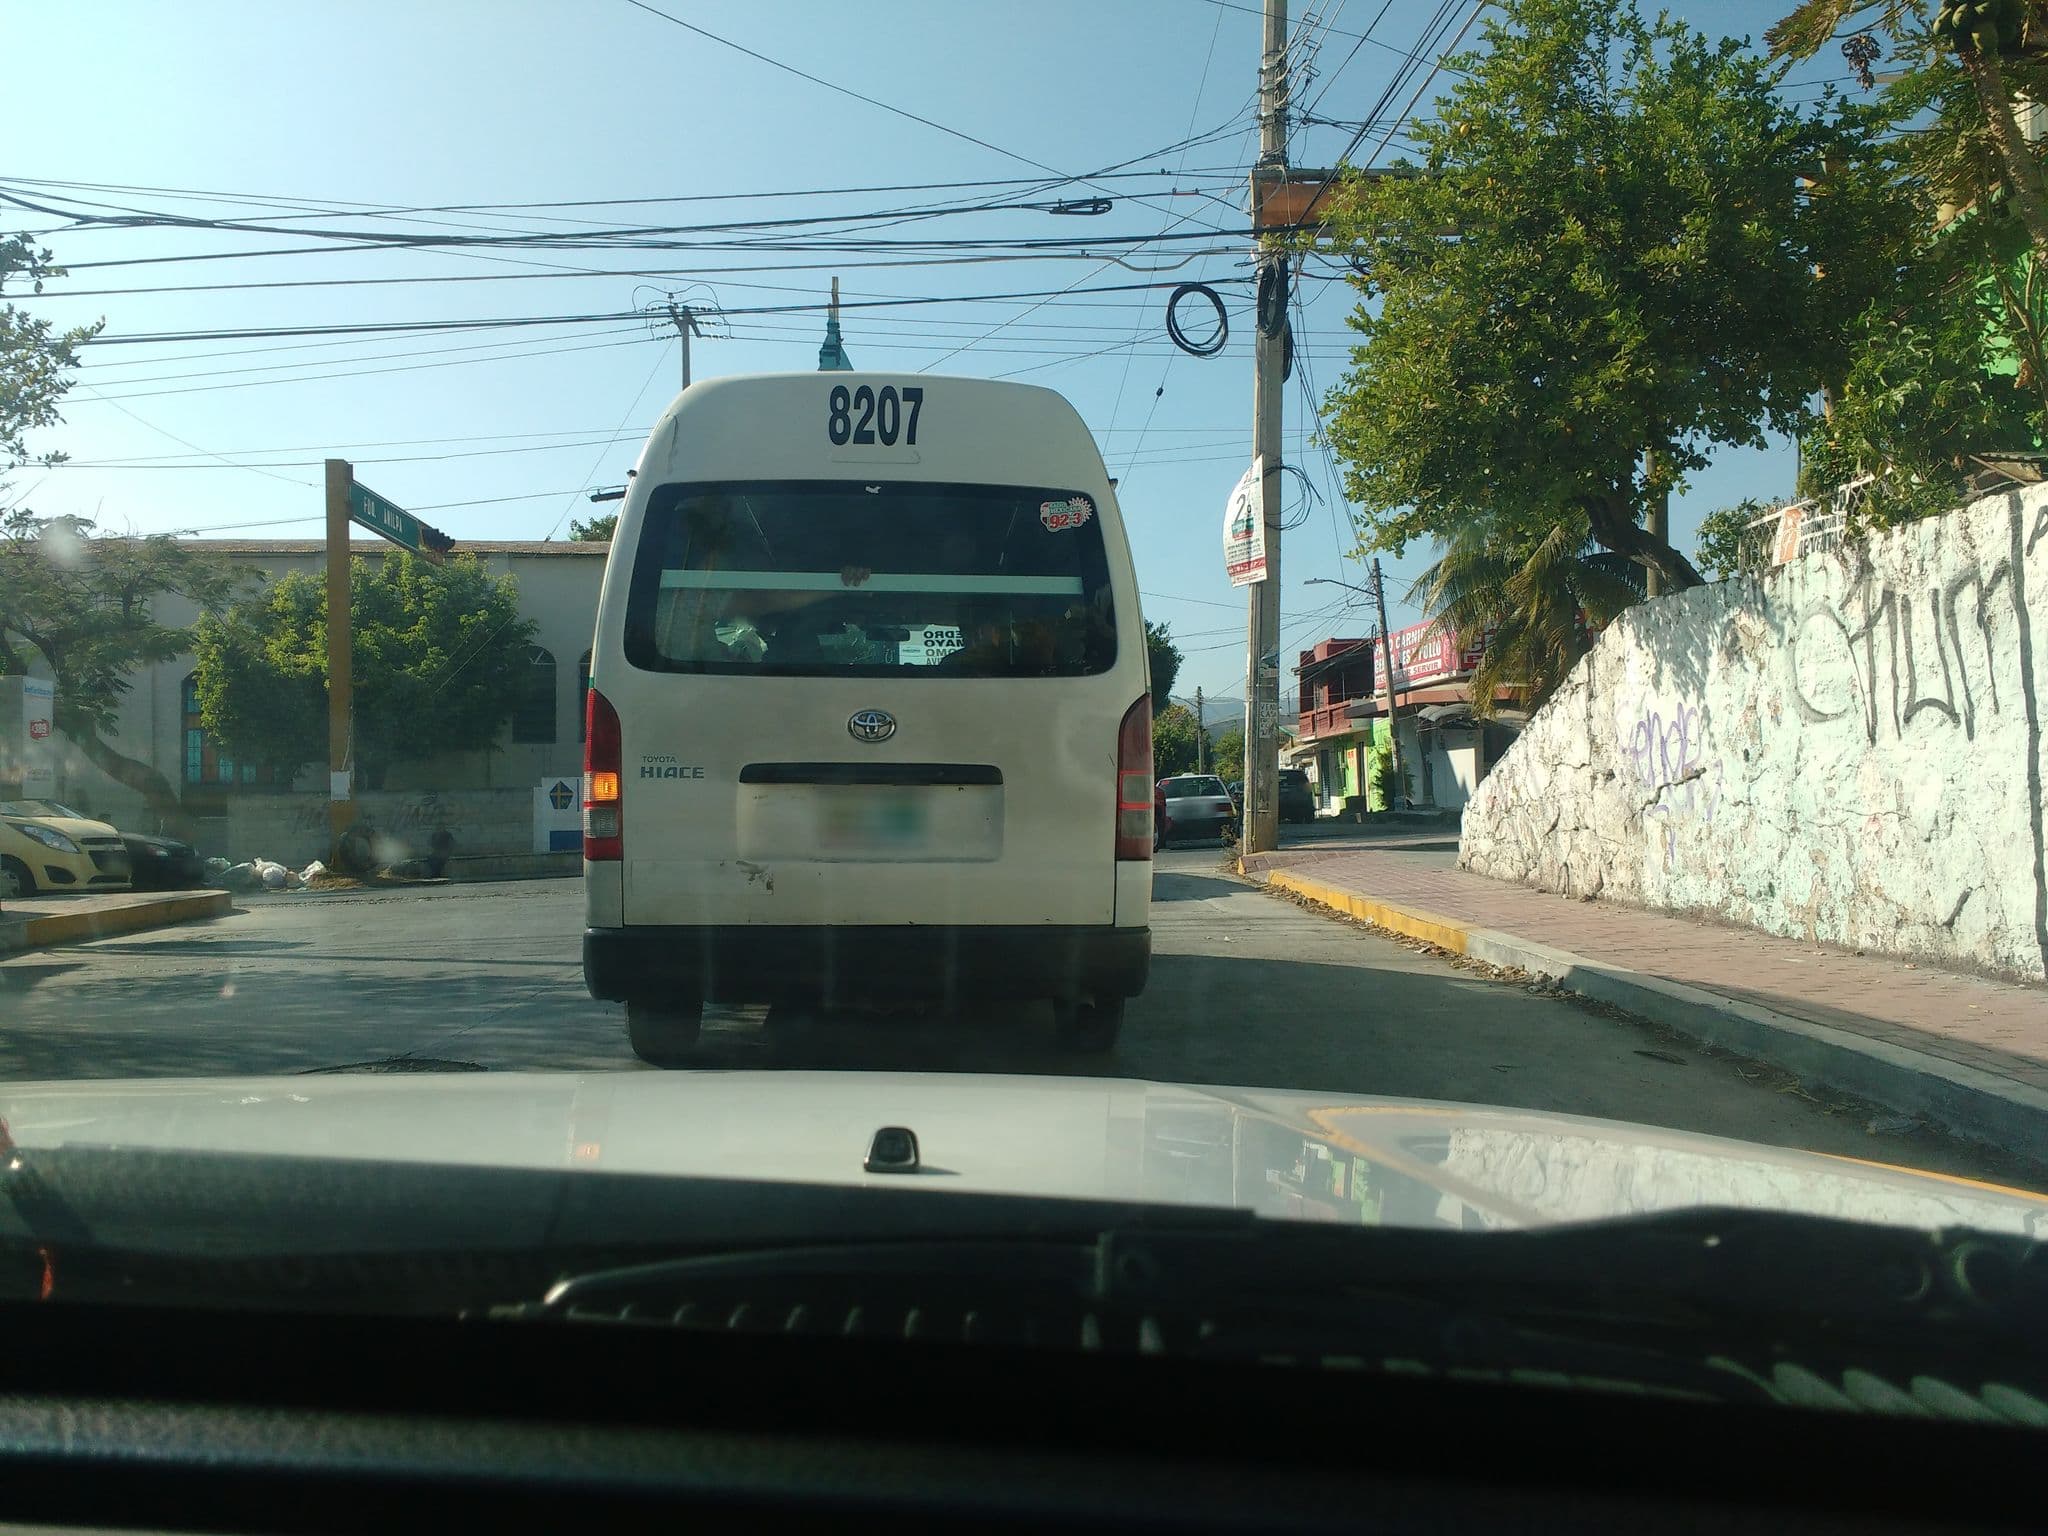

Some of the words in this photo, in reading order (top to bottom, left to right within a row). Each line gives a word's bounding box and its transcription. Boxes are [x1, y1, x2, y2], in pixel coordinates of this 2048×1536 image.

[829, 385, 923, 446] 8207
[1413, 661, 1439, 674] SERVIR
[642, 755, 677, 763] TOYOTA
[640, 766, 704, 779] HIACE
